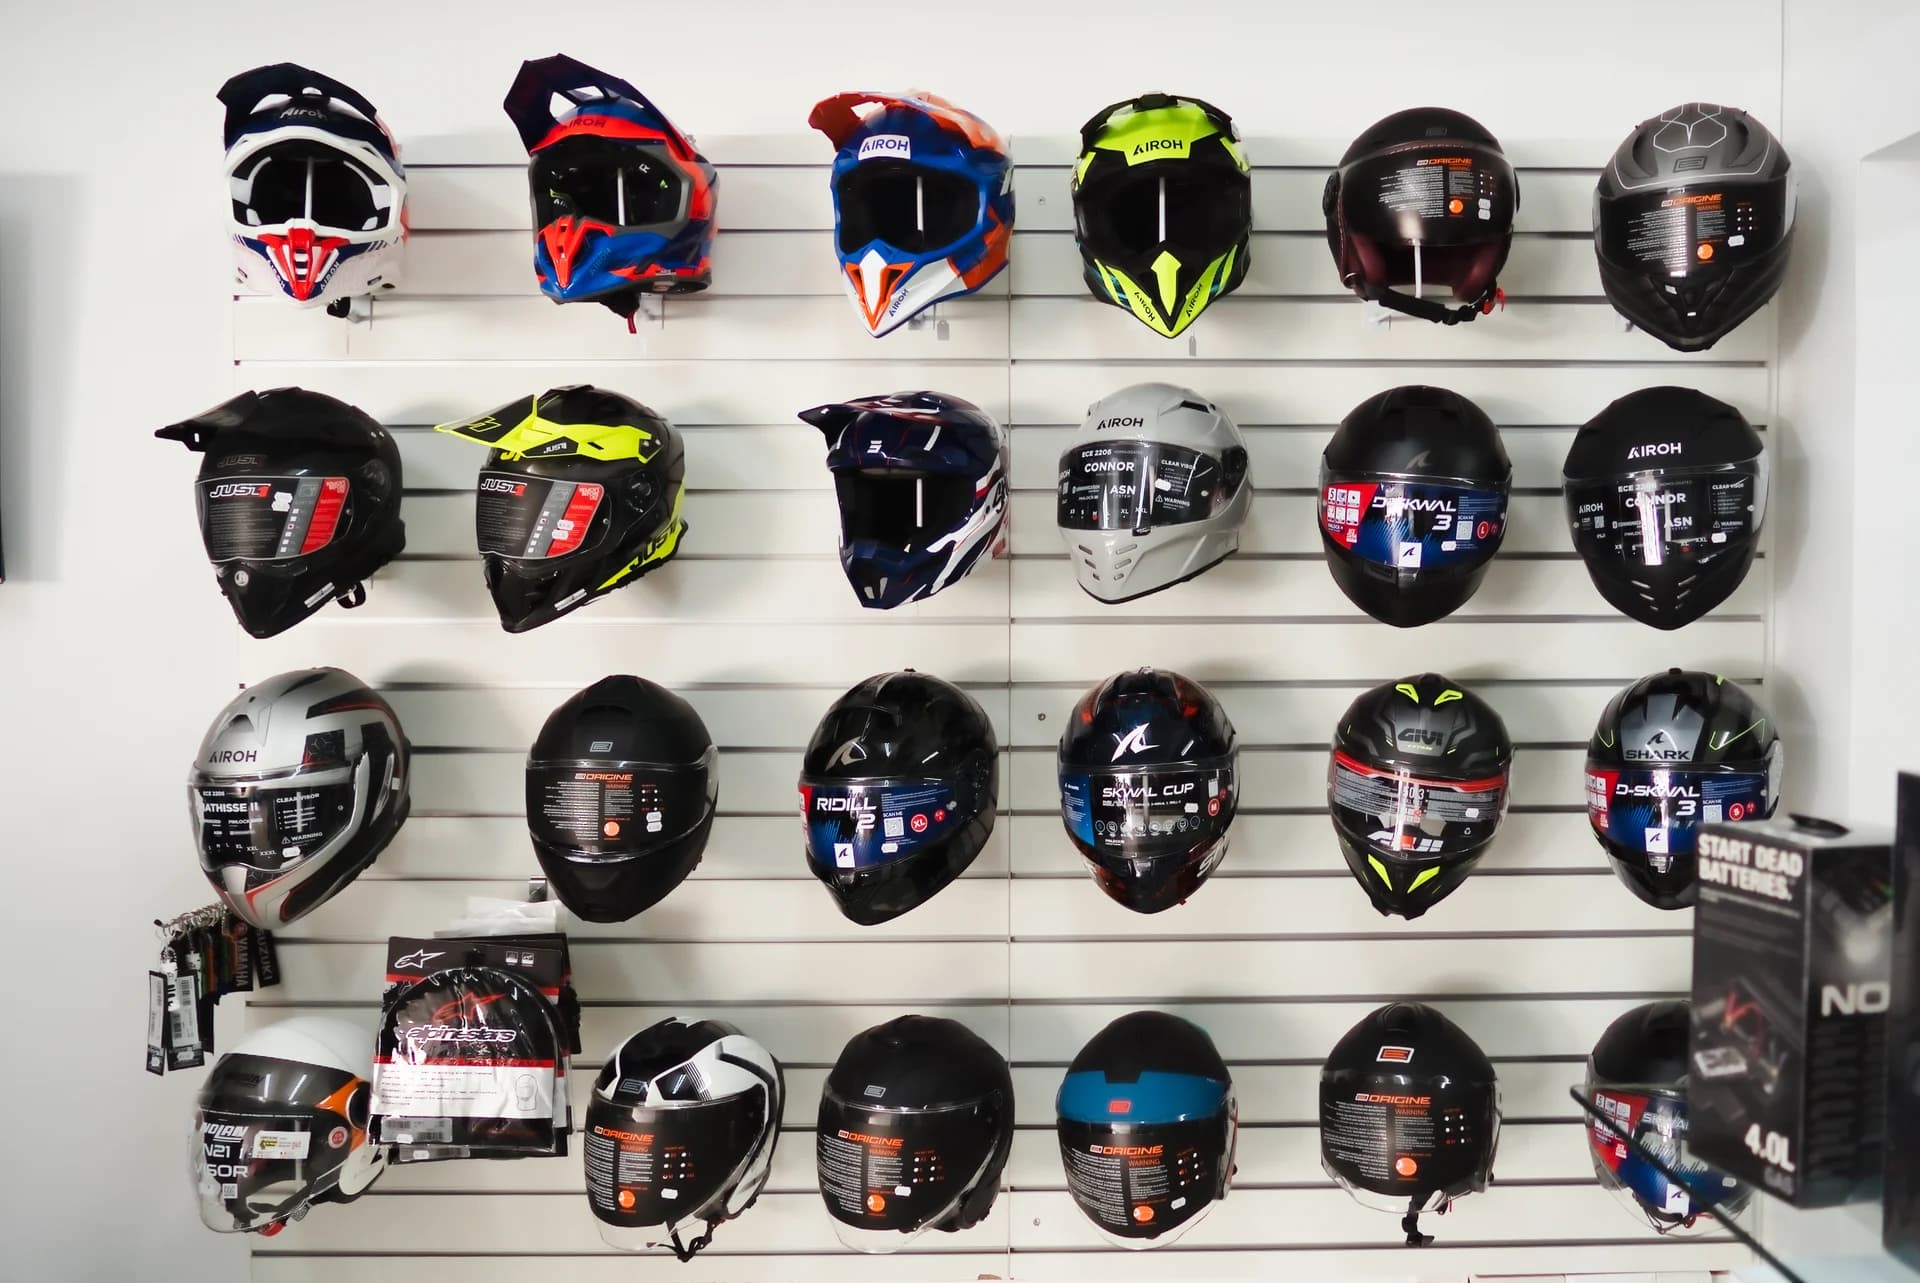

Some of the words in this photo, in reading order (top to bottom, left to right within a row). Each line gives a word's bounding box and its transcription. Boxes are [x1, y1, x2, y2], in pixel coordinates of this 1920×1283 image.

[861, 138, 909, 153] AIROH
[1133, 138, 1184, 156] AIROH
[1429, 158, 1473, 167] ORIGINE
[1672, 193, 1723, 206] ORIGINE
[888, 287, 909, 318] AIROH
[1133, 290, 1157, 323] AIROH
[1184, 282, 1204, 318] AIROH
[1096, 417, 1144, 431] AIROH
[1627, 442, 1683, 460] AIROH
[1084, 461, 1136, 473] CONNOR
[1110, 485, 1137, 495] ASN
[1163, 497, 1191, 507] WARNING
[1579, 502, 1604, 514] AIROH
[1431, 514, 1453, 531] 3
[1398, 728, 1444, 747] GIVI
[209, 750, 258, 764] AIROH
[1625, 750, 1691, 762] SHARK
[586, 773, 634, 781] ORIGINE
[1101, 785, 1158, 799] SKWAL
[1163, 782, 1195, 797] CUP
[1615, 783, 1701, 799] D-SKWAL
[816, 797, 878, 813] RIDILL
[1675, 799, 1696, 816] 3
[856, 813, 877, 834] 2
[913, 817, 927, 829] XL
[1698, 833, 1752, 866] START
[1754, 844, 1804, 878] DEAD
[1698, 857, 1793, 901] BATTERIES.
[236, 938, 249, 987] YAMAHA
[406, 1024, 518, 1045] alpinestars
[1368, 1094, 1432, 1105] ORIGINE
[1395, 1108, 1428, 1116] WARNING
[200, 1122, 249, 1143] NOLAN
[602, 1129, 655, 1143] ORIGINE
[848, 1133, 904, 1147] ORIGINE
[1103, 1145, 1164, 1156] ORIGINE
[1744, 1122, 1796, 1172] 4.0L
[1128, 1158, 1161, 1167] WARNING
